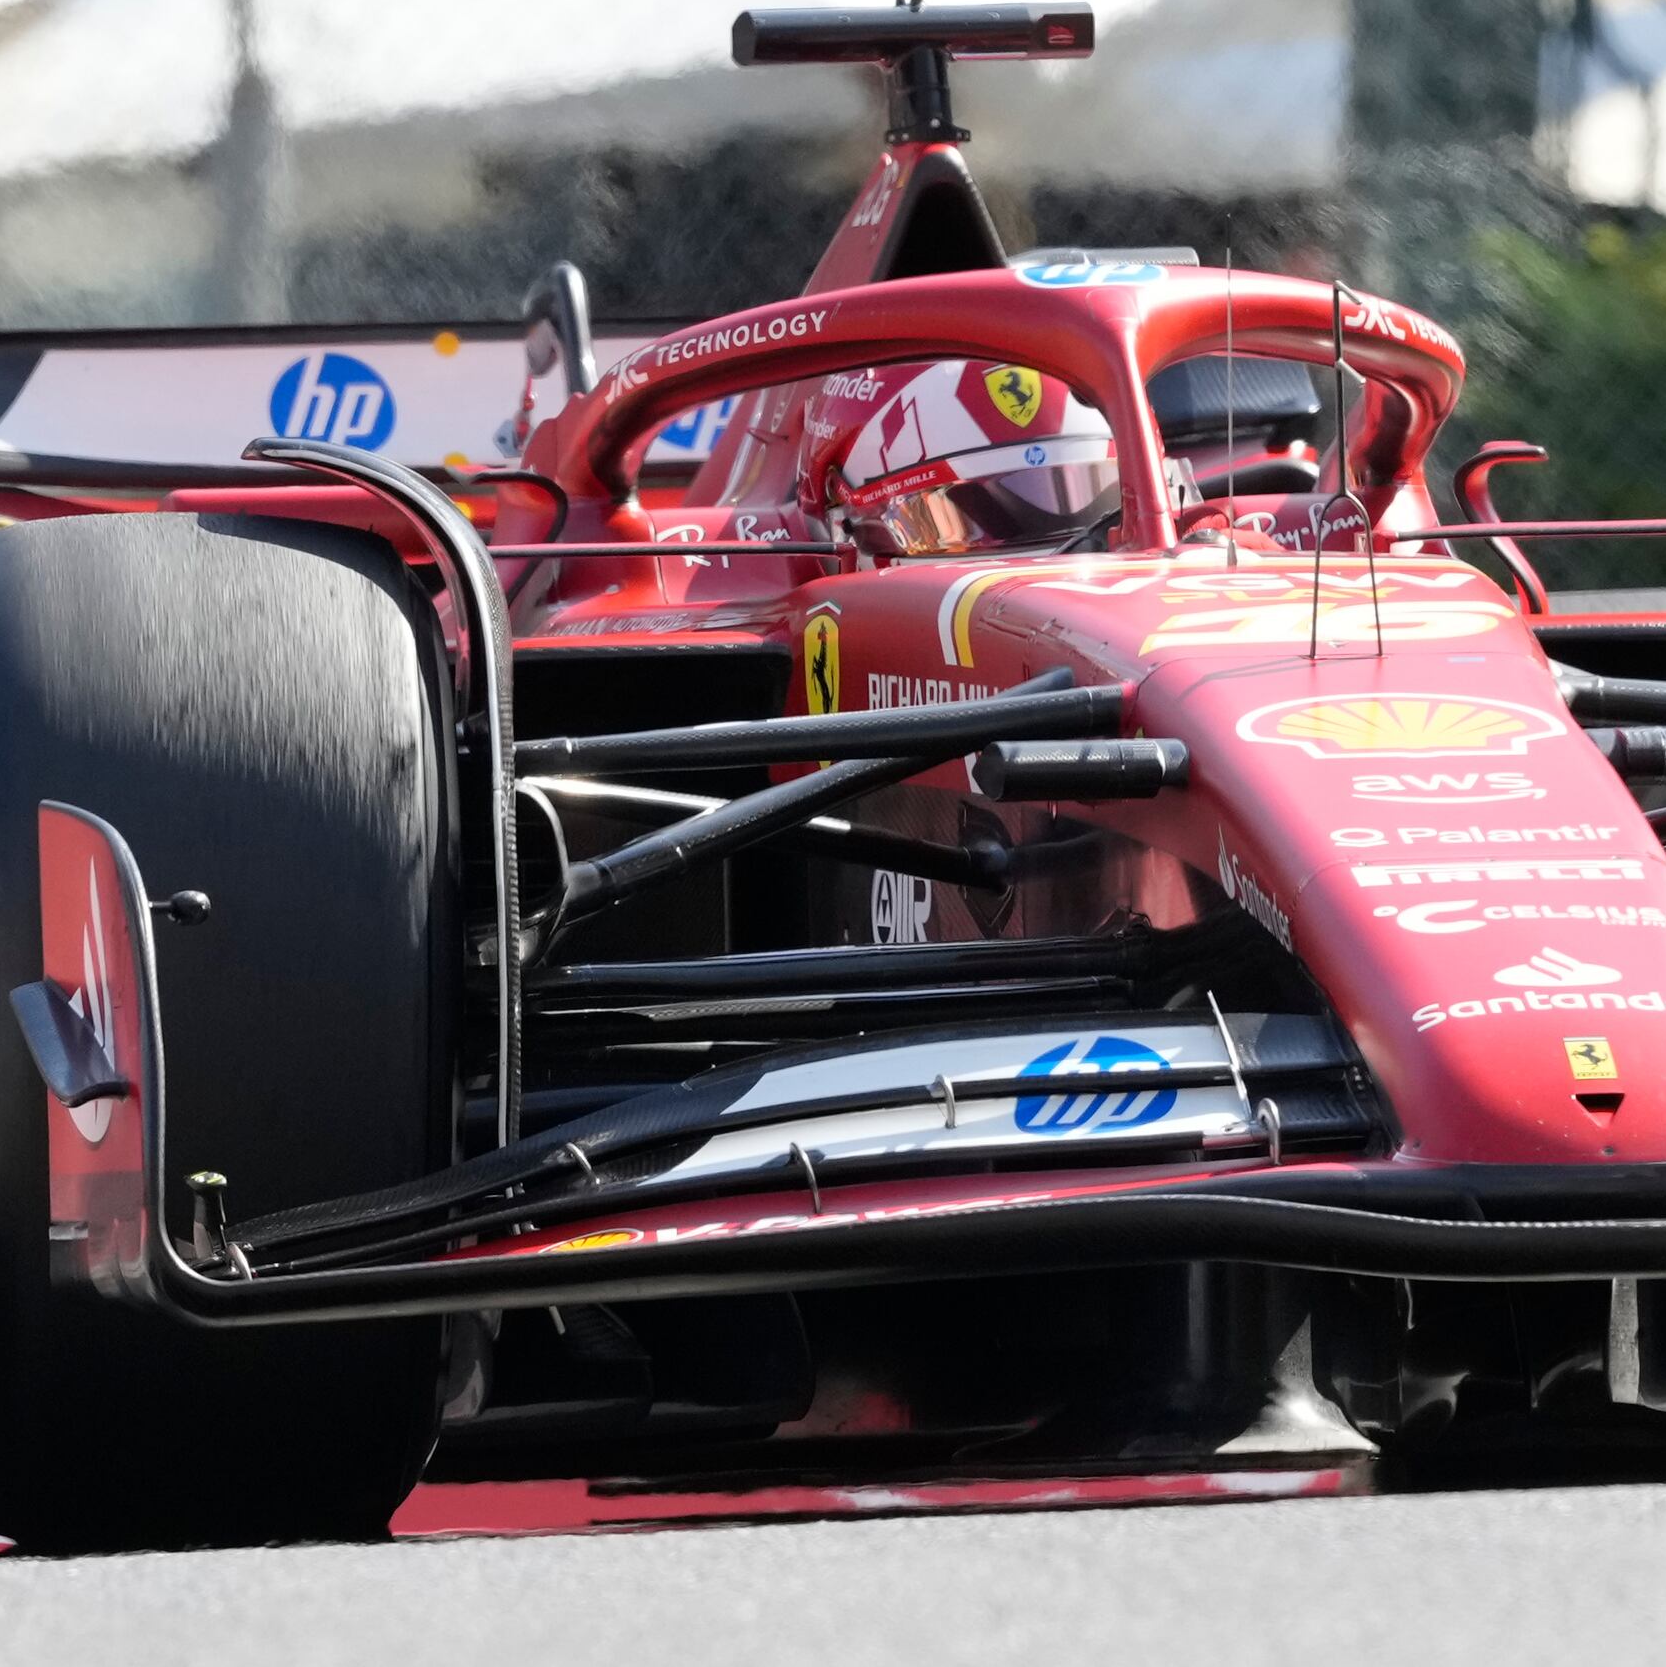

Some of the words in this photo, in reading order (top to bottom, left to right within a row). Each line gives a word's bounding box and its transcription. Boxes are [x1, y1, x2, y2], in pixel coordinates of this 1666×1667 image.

[656, 310, 827, 367] TECHNOLOGY
[283, 353, 389, 447] hp
[1025, 445, 1046, 466] hp
[1025, 572, 1477, 595] VGW
[1137, 601, 1519, 657] 16
[1351, 772, 1534, 792] aws
[1396, 823, 1620, 845] Palantir
[1350, 860, 1646, 887] PIRELLI
[1483, 905, 1666, 921] CELSIUS
[1023, 1036, 1175, 1136] hp
